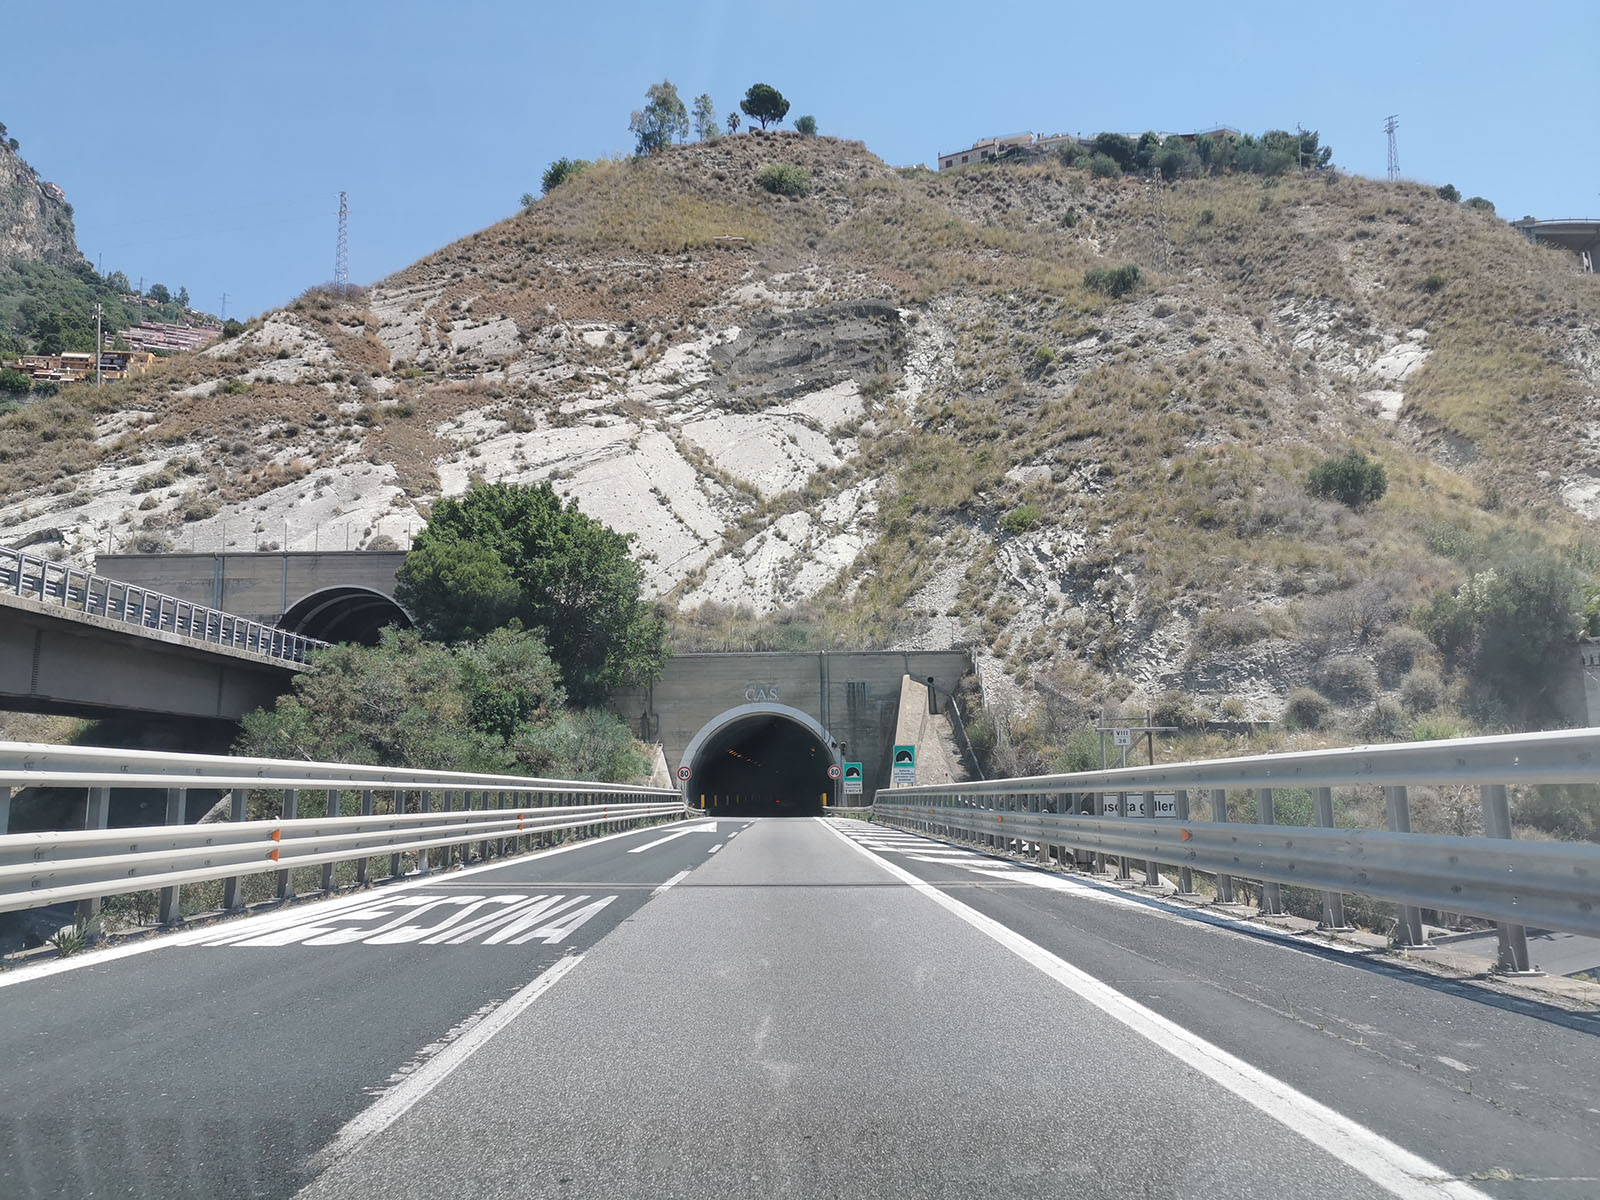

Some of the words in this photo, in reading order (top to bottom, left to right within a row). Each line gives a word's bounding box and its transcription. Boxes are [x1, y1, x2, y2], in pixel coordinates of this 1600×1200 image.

[680, 770, 689, 778] 80
[831, 768, 839, 776] 80
[175, 895, 619, 947] MESSINA
